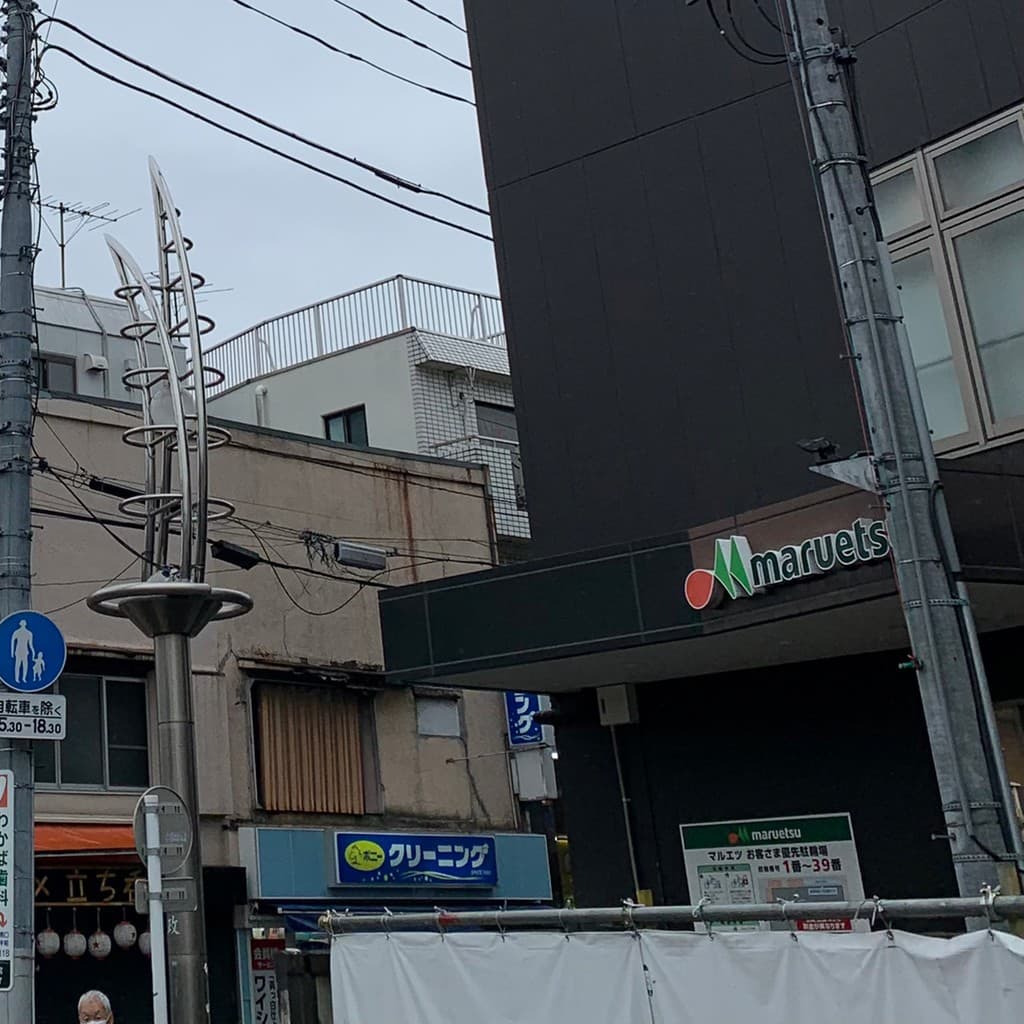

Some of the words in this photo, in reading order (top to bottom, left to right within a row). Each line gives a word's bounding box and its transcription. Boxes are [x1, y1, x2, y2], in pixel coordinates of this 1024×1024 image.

[750, 519, 890, 587] maruets
[751, 827, 802, 841] maruetsu
[389, 843, 489, 868] クリーニング
[707, 849, 743, 862] マルエツ
